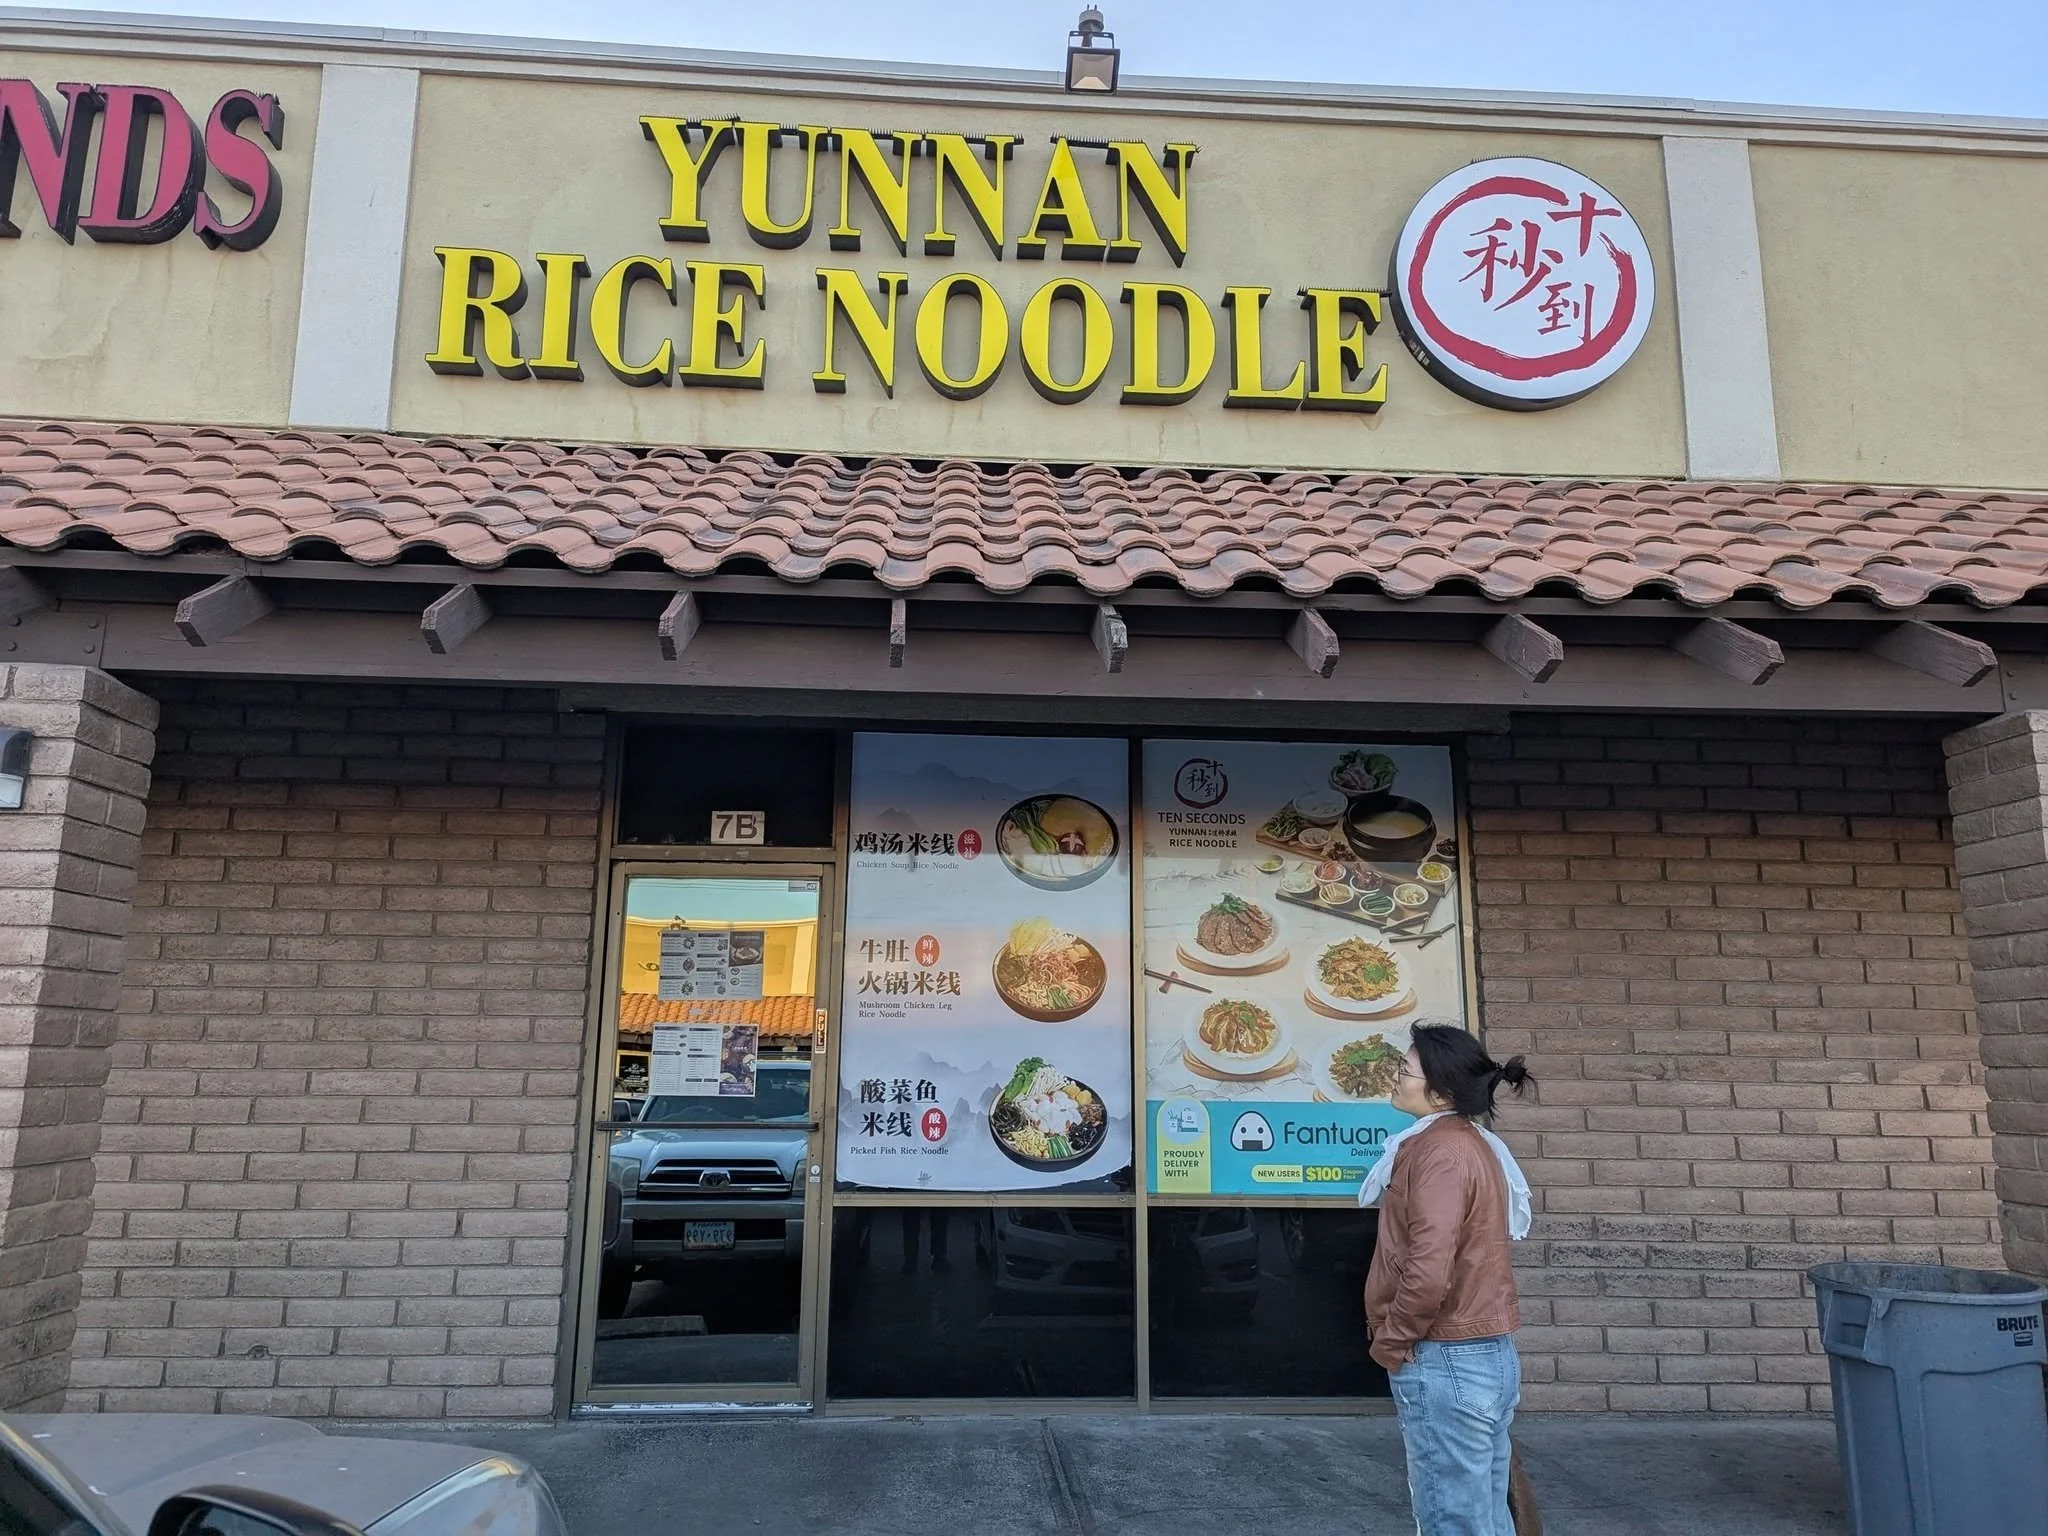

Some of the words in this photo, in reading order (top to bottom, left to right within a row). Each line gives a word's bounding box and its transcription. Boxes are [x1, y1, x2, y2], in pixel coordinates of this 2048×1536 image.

[638, 115, 1196, 267] YUNNAN
[425, 246, 766, 389] RICE
[813, 268, 1388, 413] NOODLE
[714, 814, 758, 840] 7B
[1158, 812, 1183, 824] TEN
[1186, 813, 1246, 825] SECONDS
[852, 831, 955, 857] 鸡汤米线
[1169, 839, 1193, 848] RICE
[1196, 840, 1238, 849] NOODLE
[856, 861, 888, 869] Chicken
[890, 862, 910, 870] Soup
[933, 862, 960, 870] Noodle
[858, 939, 910, 963] 牛肚
[922, 939, 934, 964] 鲜辣
[857, 970, 961, 996] 火锅米线
[859, 1001, 900, 1009] Mushroom
[904, 1001, 935, 1009] Chicken
[938, 1001, 952, 1011] Leg
[860, 1078, 940, 1104] 酸菜鱼
[859, 1112, 912, 1137] 米线
[928, 1112, 941, 1139] 酸辣
[1284, 1121, 1389, 1145] Fantuan
[850, 1147, 877, 1155] Picked
[880, 1147, 897, 1155] Fish
[900, 1147, 918, 1155] Rice
[921, 1147, 949, 1155] Noodle
[1164, 1150, 1205, 1158] PROUDLY
[1350, 1148, 1386, 1157] Deliver
[1164, 1160, 1199, 1168] DELIVER
[1257, 1170, 1275, 1178] NEW
[1277, 1170, 1301, 1178] USERS
[1306, 1166, 1342, 1181] $100
[1996, 1315, 2040, 1332] BRUTE
